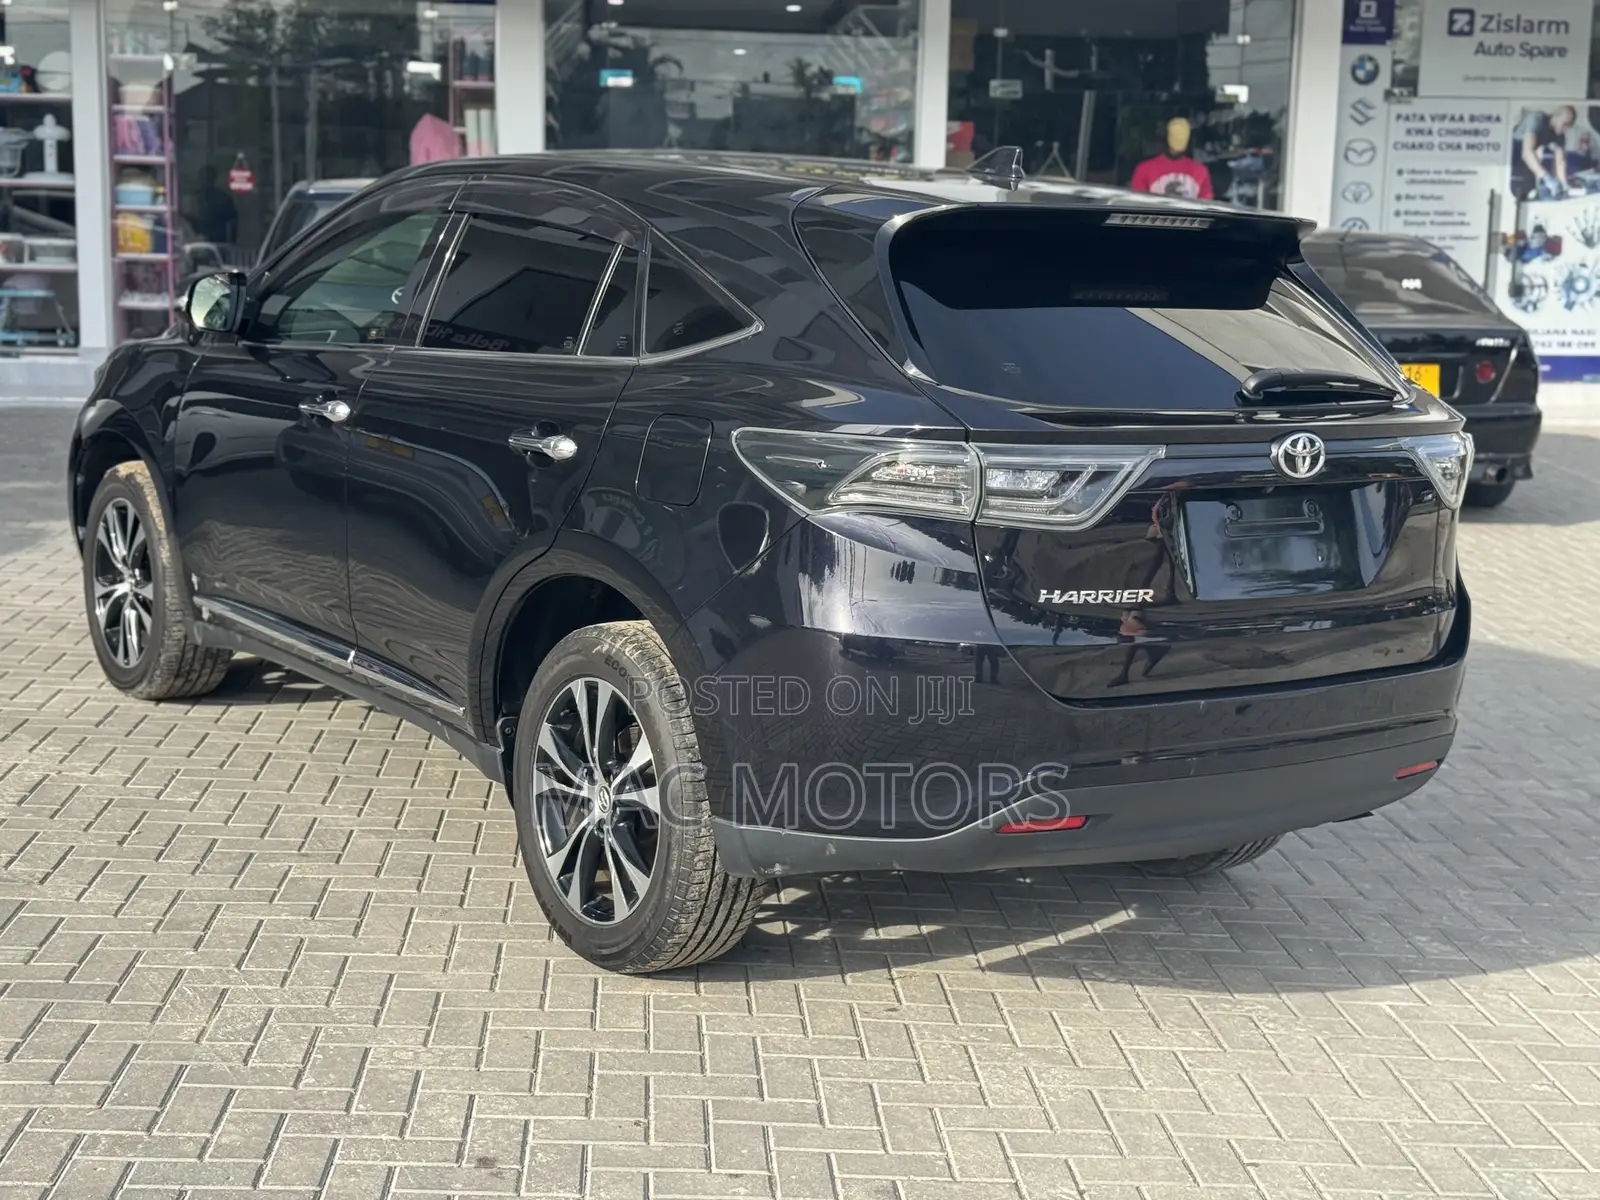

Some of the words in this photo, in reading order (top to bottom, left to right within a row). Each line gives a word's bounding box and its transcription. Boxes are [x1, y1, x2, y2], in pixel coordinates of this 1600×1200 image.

[1480, 13, 1570, 34] Zislarm
[1473, 40, 1516, 57] Auto
[1519, 41, 1569, 61] Spare
[1395, 113, 1426, 123] PATA
[1429, 113, 1466, 123] VIFAA
[1468, 113, 1502, 123] BORA
[1405, 128, 1435, 137] KWA
[1436, 128, 1491, 138] CHOMBO
[1393, 141, 1436, 151] CHAKO
[1438, 142, 1463, 151] CHA
[1465, 142, 1502, 152] MOTO
[1038, 588, 1155, 604] HARRIER
